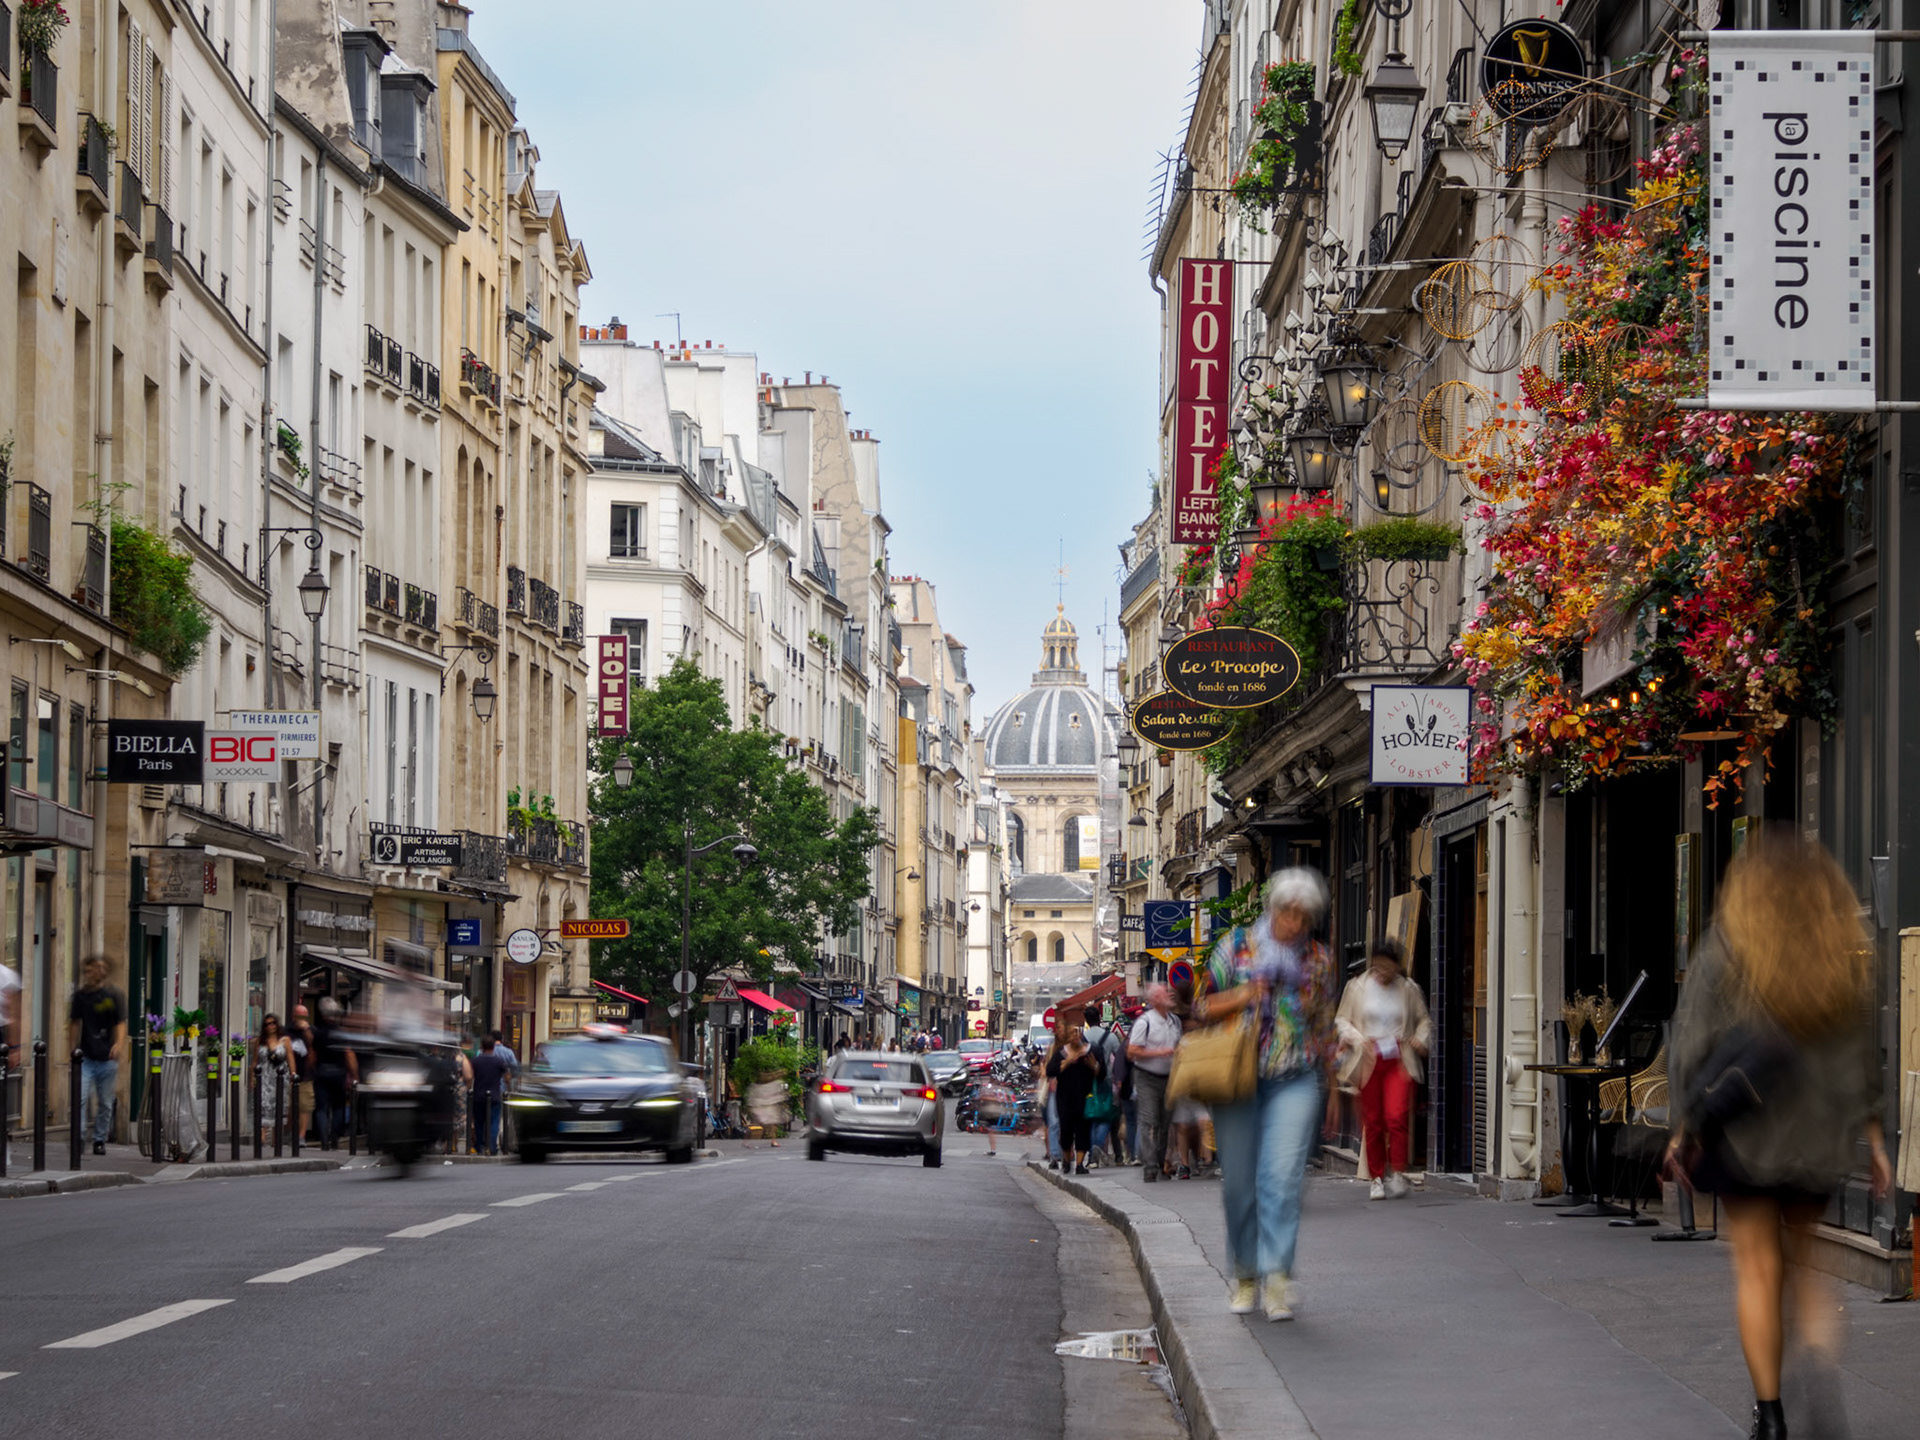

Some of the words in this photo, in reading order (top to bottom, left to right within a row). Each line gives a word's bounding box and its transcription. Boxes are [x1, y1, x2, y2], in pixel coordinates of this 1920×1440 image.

[1495, 80, 1573, 96] GUINNESS
[1785, 122, 1799, 136] la
[1762, 112, 1821, 329] piscine
[1189, 263, 1224, 495] HOTEL
[1182, 497, 1219, 510] LEFT
[1179, 511, 1220, 525] BANK
[1188, 640, 1276, 652] RESTAURANT
[1181, 660, 1207, 674] Le
[1210, 660, 1285, 678] Procope
[602, 642, 625, 729] HOTEL
[1197, 681, 1225, 692] fondé
[1227, 684, 1239, 692] en
[1242, 682, 1267, 692] 1686
[1141, 713, 1176, 728] Salon
[1178, 712, 1197, 725] de
[1386, 700, 1408, 720] ALL
[1428, 698, 1461, 729] ABOUT
[1159, 730, 1180, 738] fondé
[1193, 730, 1212, 738] 1686
[115, 735, 197, 755] BIELLA
[1381, 732, 1460, 751] HOMER
[210, 737, 275, 762] BIG
[281, 748, 289, 756] 21
[292, 748, 301, 756] 57
[138, 758, 173, 770] Paris
[1390, 758, 1452, 779] LOBSTER
[215, 768, 270, 776] XXXXXL
[402, 836, 422, 845] ERIC
[426, 836, 460, 846] KAYSER
[414, 848, 447, 856] ARTISAN
[407, 856, 453, 864] BOULANGER
[568, 922, 621, 934] NICOLAS
[598, 1005, 626, 1016] Blend
